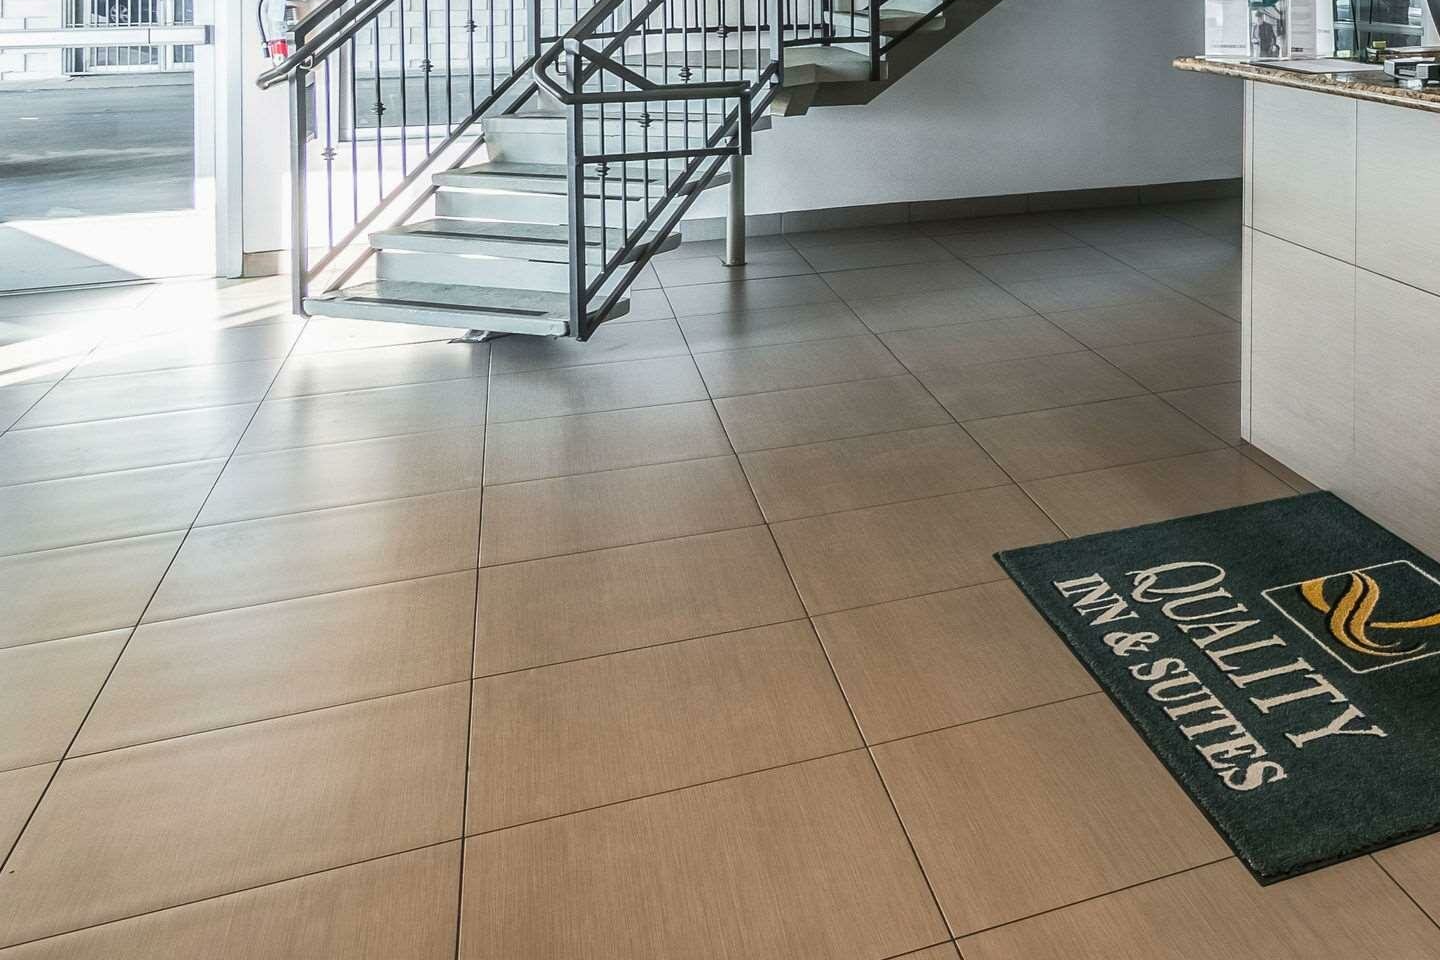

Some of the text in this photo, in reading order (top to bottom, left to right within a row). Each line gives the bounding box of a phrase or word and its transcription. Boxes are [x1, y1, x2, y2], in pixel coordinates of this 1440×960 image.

[1053, 572, 1288, 793] INN & SUITES
[1126, 561, 1388, 748] QUALITY
